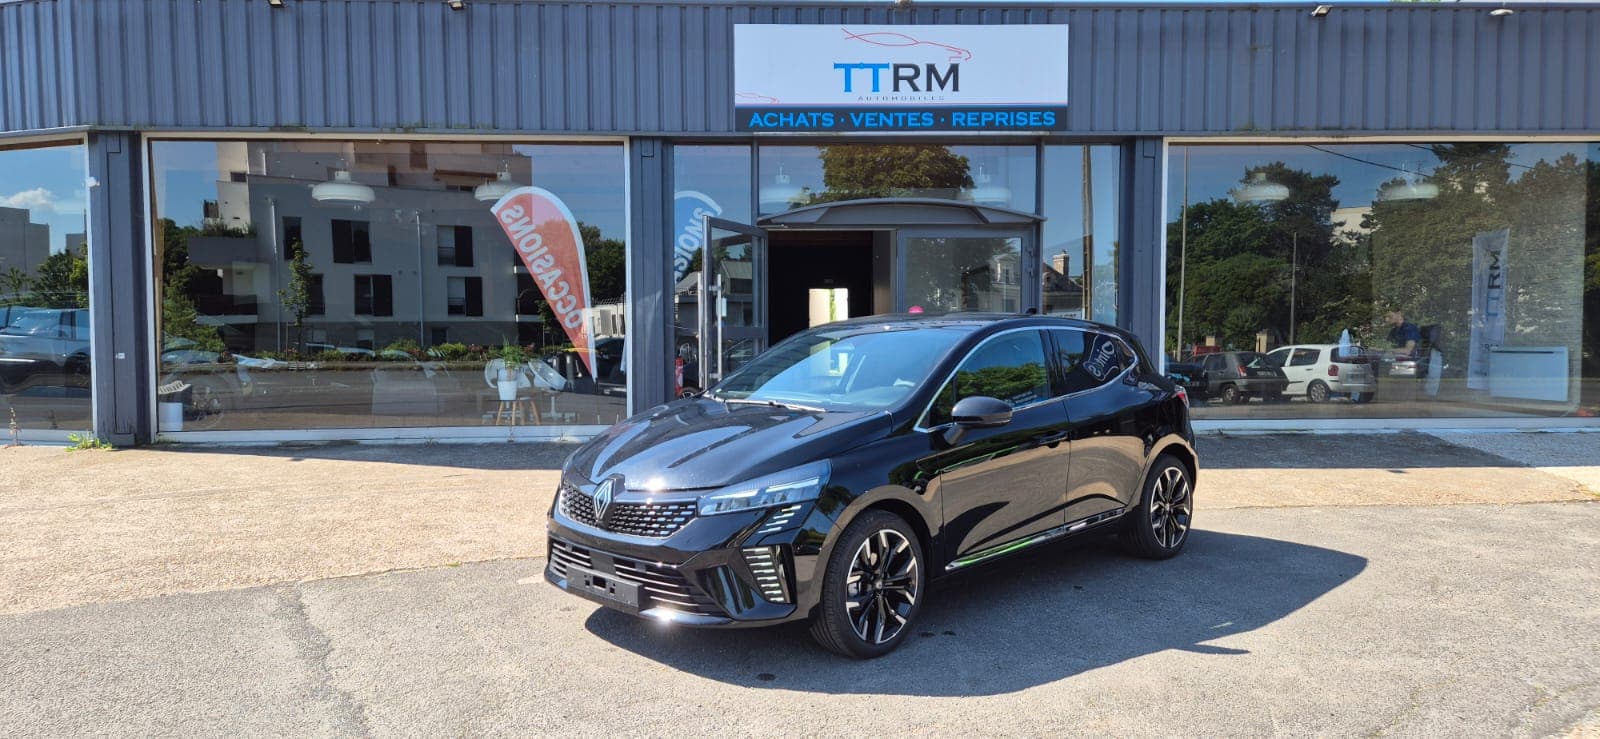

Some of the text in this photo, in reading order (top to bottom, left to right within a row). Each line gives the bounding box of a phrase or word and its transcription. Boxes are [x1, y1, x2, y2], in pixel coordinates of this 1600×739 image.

[833, 62, 960, 93] TTRM
[750, 111, 1056, 128] ACHATS VENTES REPRISES
